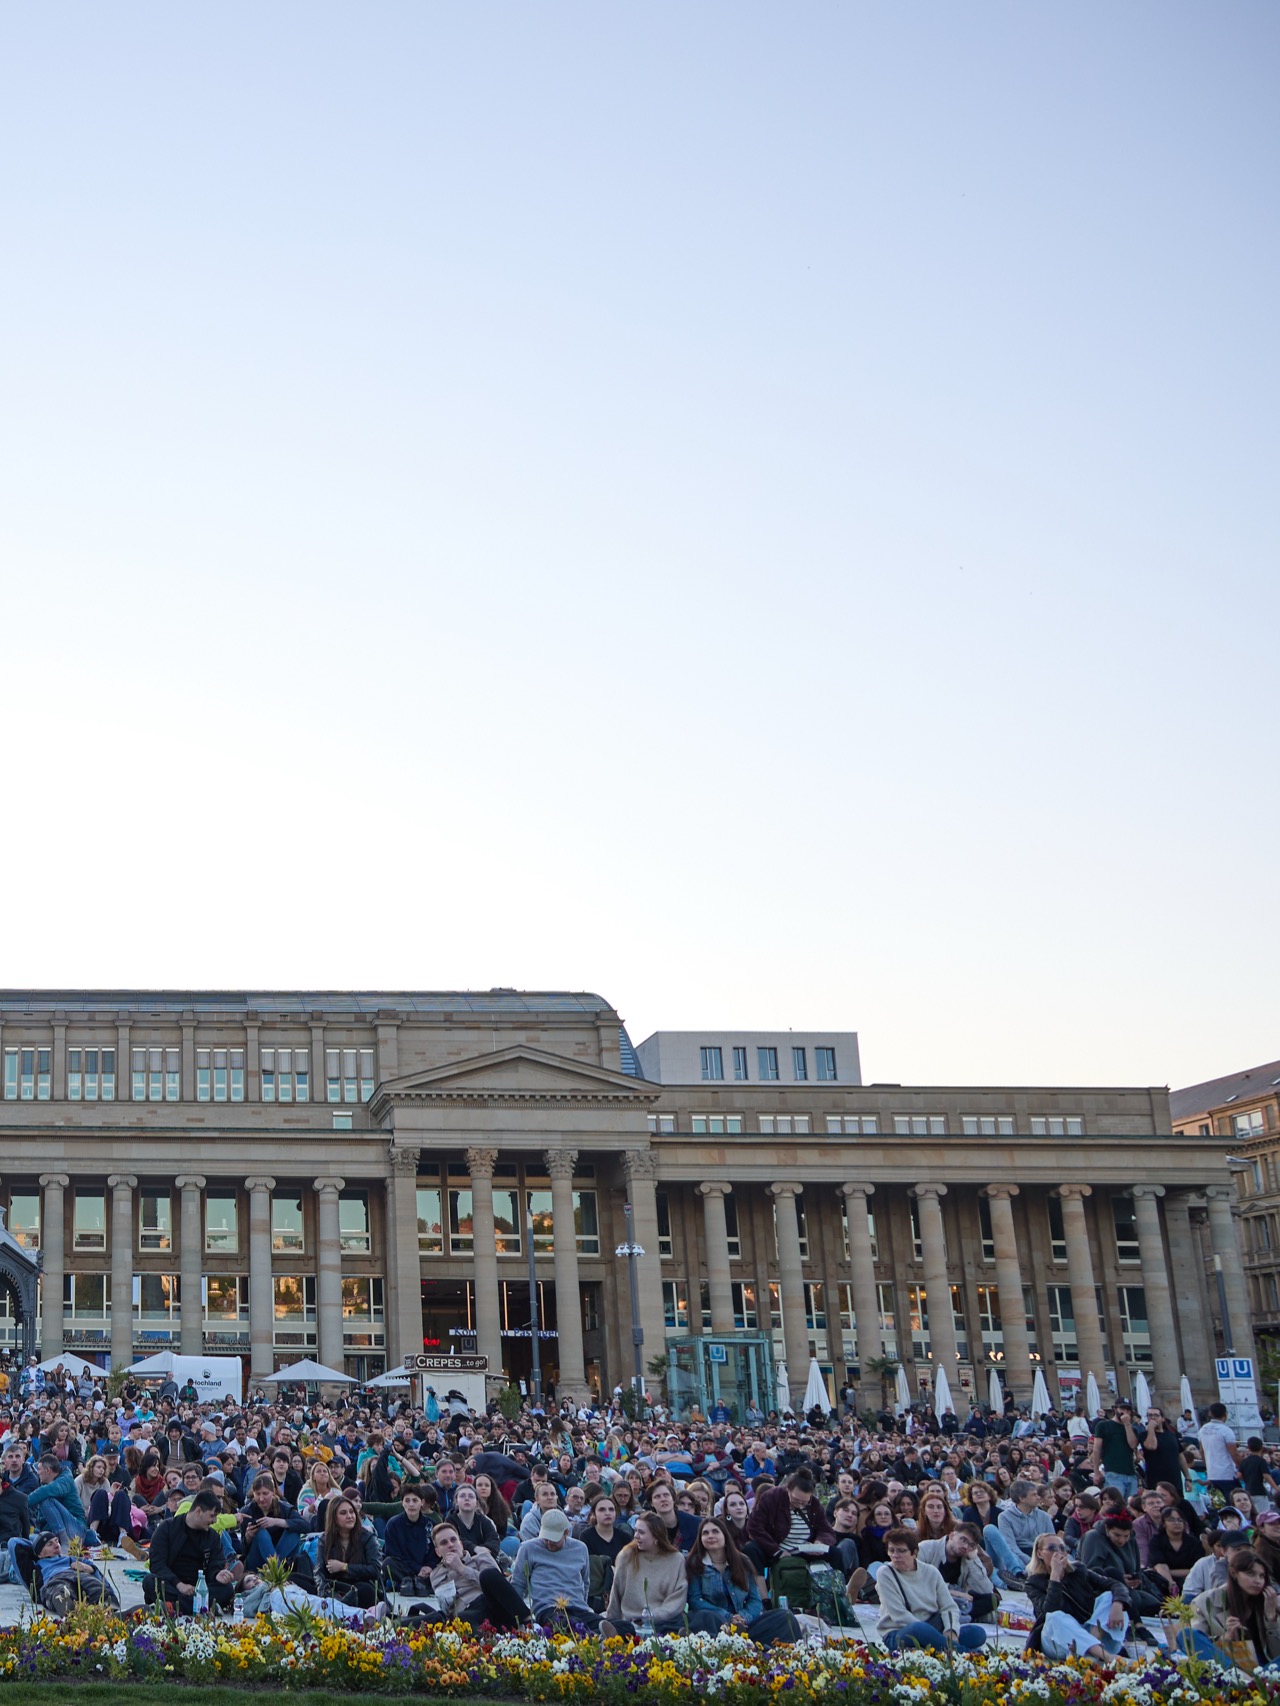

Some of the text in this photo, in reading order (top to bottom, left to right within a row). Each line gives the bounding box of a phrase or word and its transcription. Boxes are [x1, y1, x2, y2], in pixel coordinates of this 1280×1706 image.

[416, 1356, 462, 1368] CREPES
[1218, 1361, 1228, 1374] U
[1235, 1361, 1249, 1374] U
